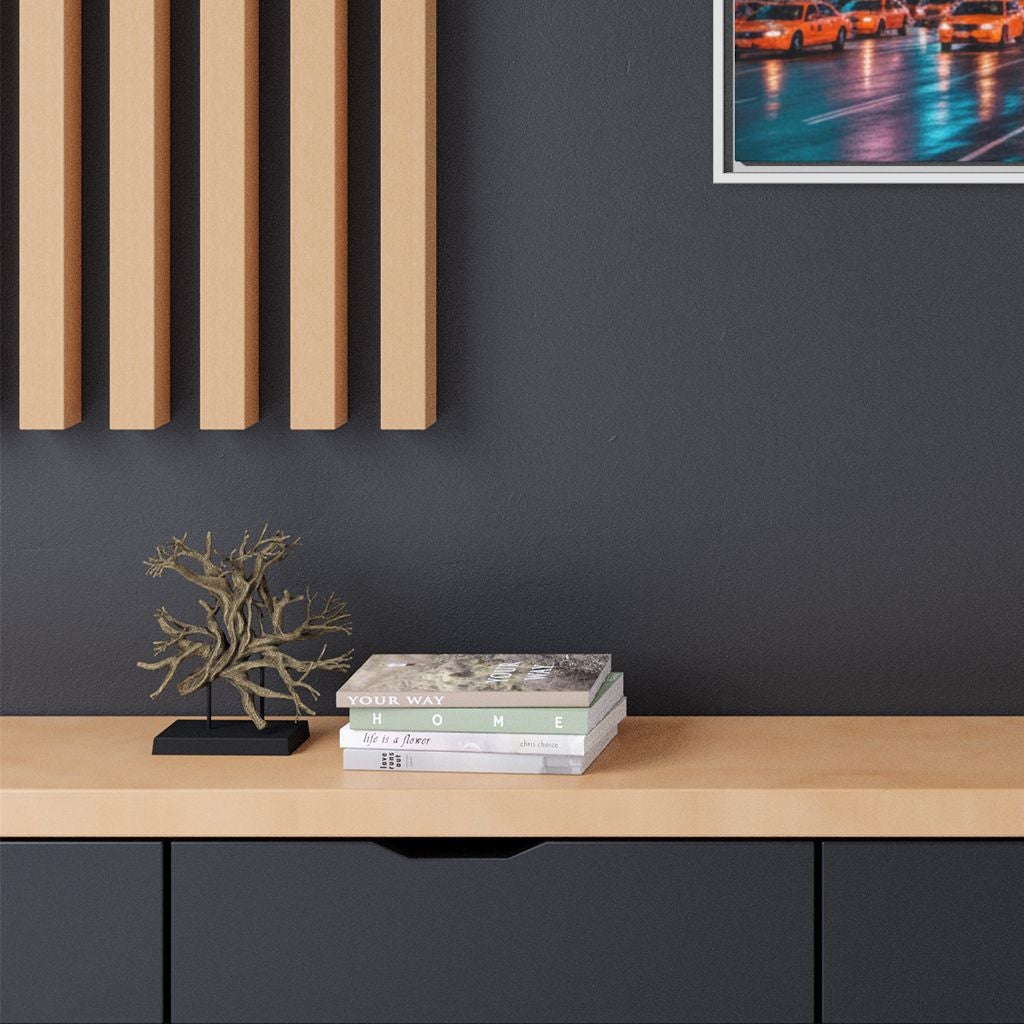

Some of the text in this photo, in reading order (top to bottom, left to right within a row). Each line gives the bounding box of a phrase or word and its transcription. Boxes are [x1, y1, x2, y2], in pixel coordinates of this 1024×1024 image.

[348, 695, 446, 706] YOUR WAY
[372, 712, 564, 729] HOME
[362, 733, 379, 747] life
[382, 735, 390, 744] is
[400, 733, 432, 748] flower
[520, 739, 559, 749] chris choice
[379, 752, 388, 769] love
